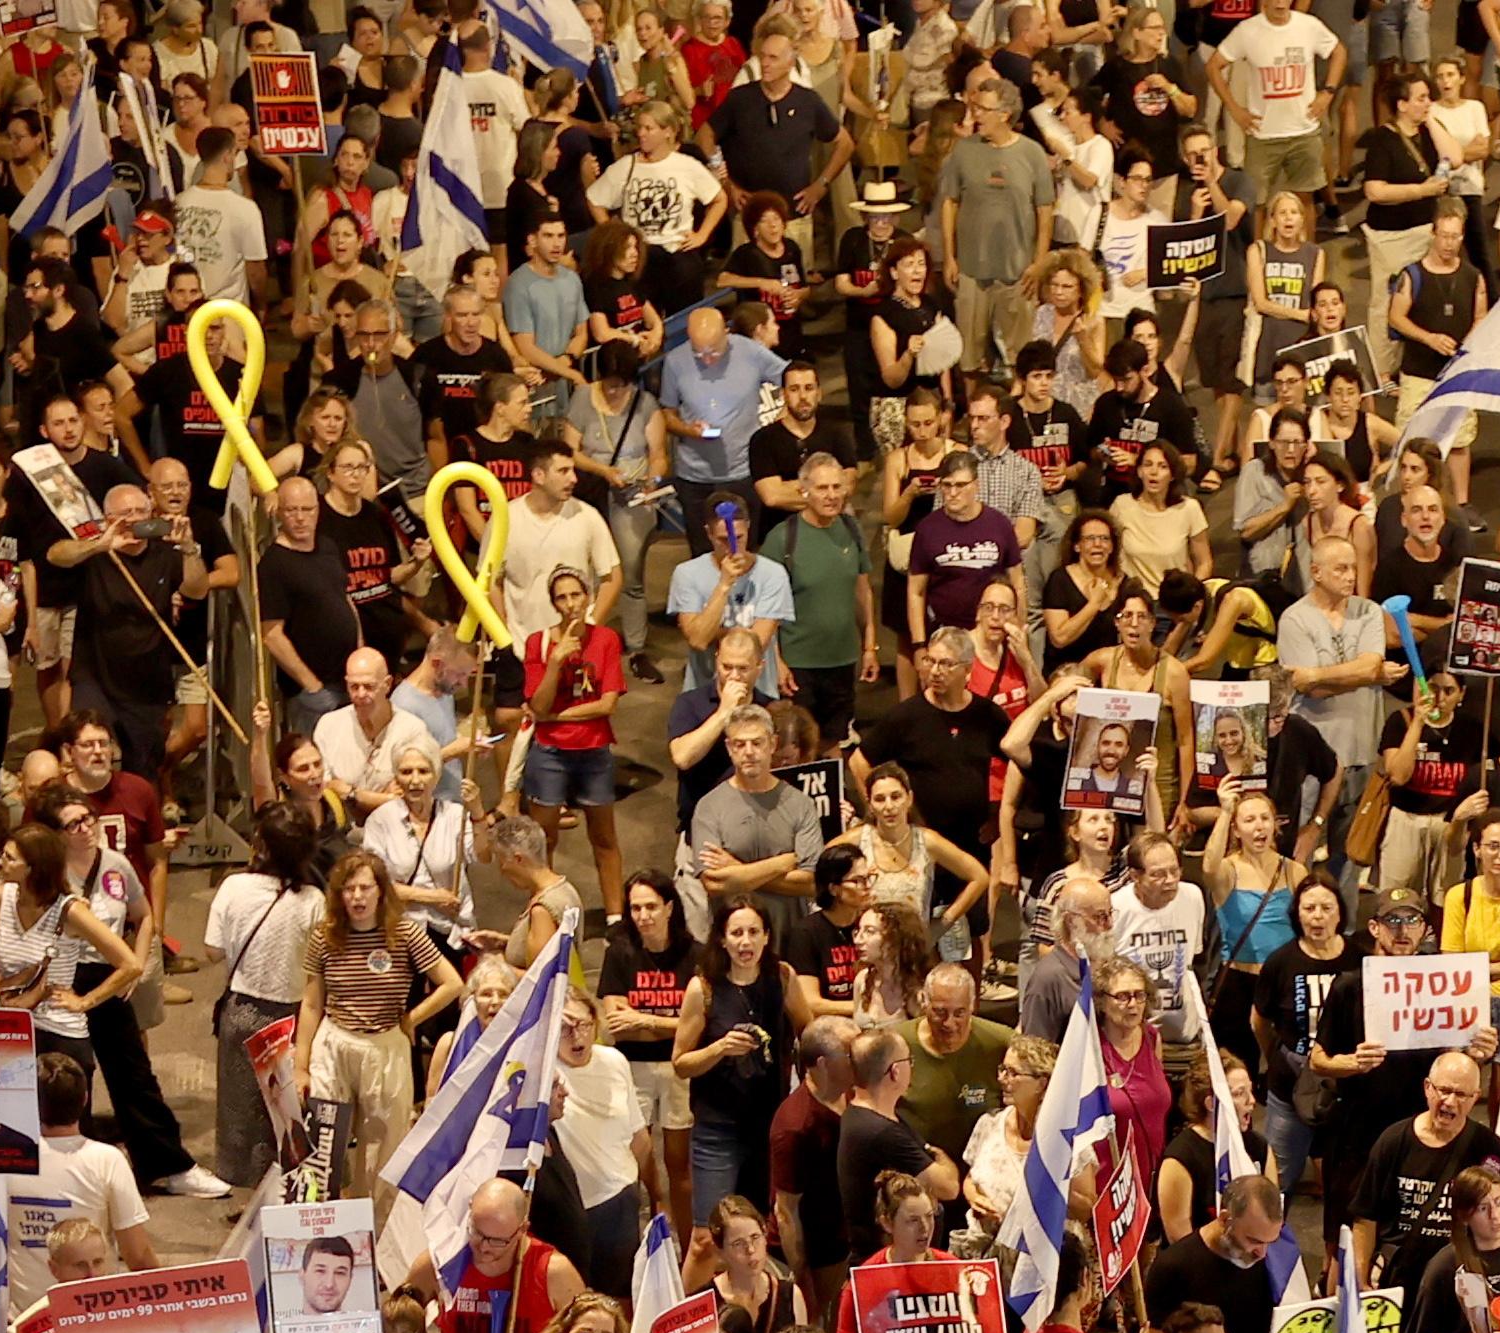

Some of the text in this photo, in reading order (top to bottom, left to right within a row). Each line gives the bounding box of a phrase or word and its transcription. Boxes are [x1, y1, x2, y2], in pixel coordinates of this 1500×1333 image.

[1165, 234, 1217, 259] עסקה
[1382, 970, 1473, 1006] עסקה
[1390, 1004, 1478, 1034] עכשיו
[58, 1291, 248, 1326] נרצח בשבי אחרי 99 ימים של סיוט
[73, 1274, 227, 1313] איתי סבירסקי
